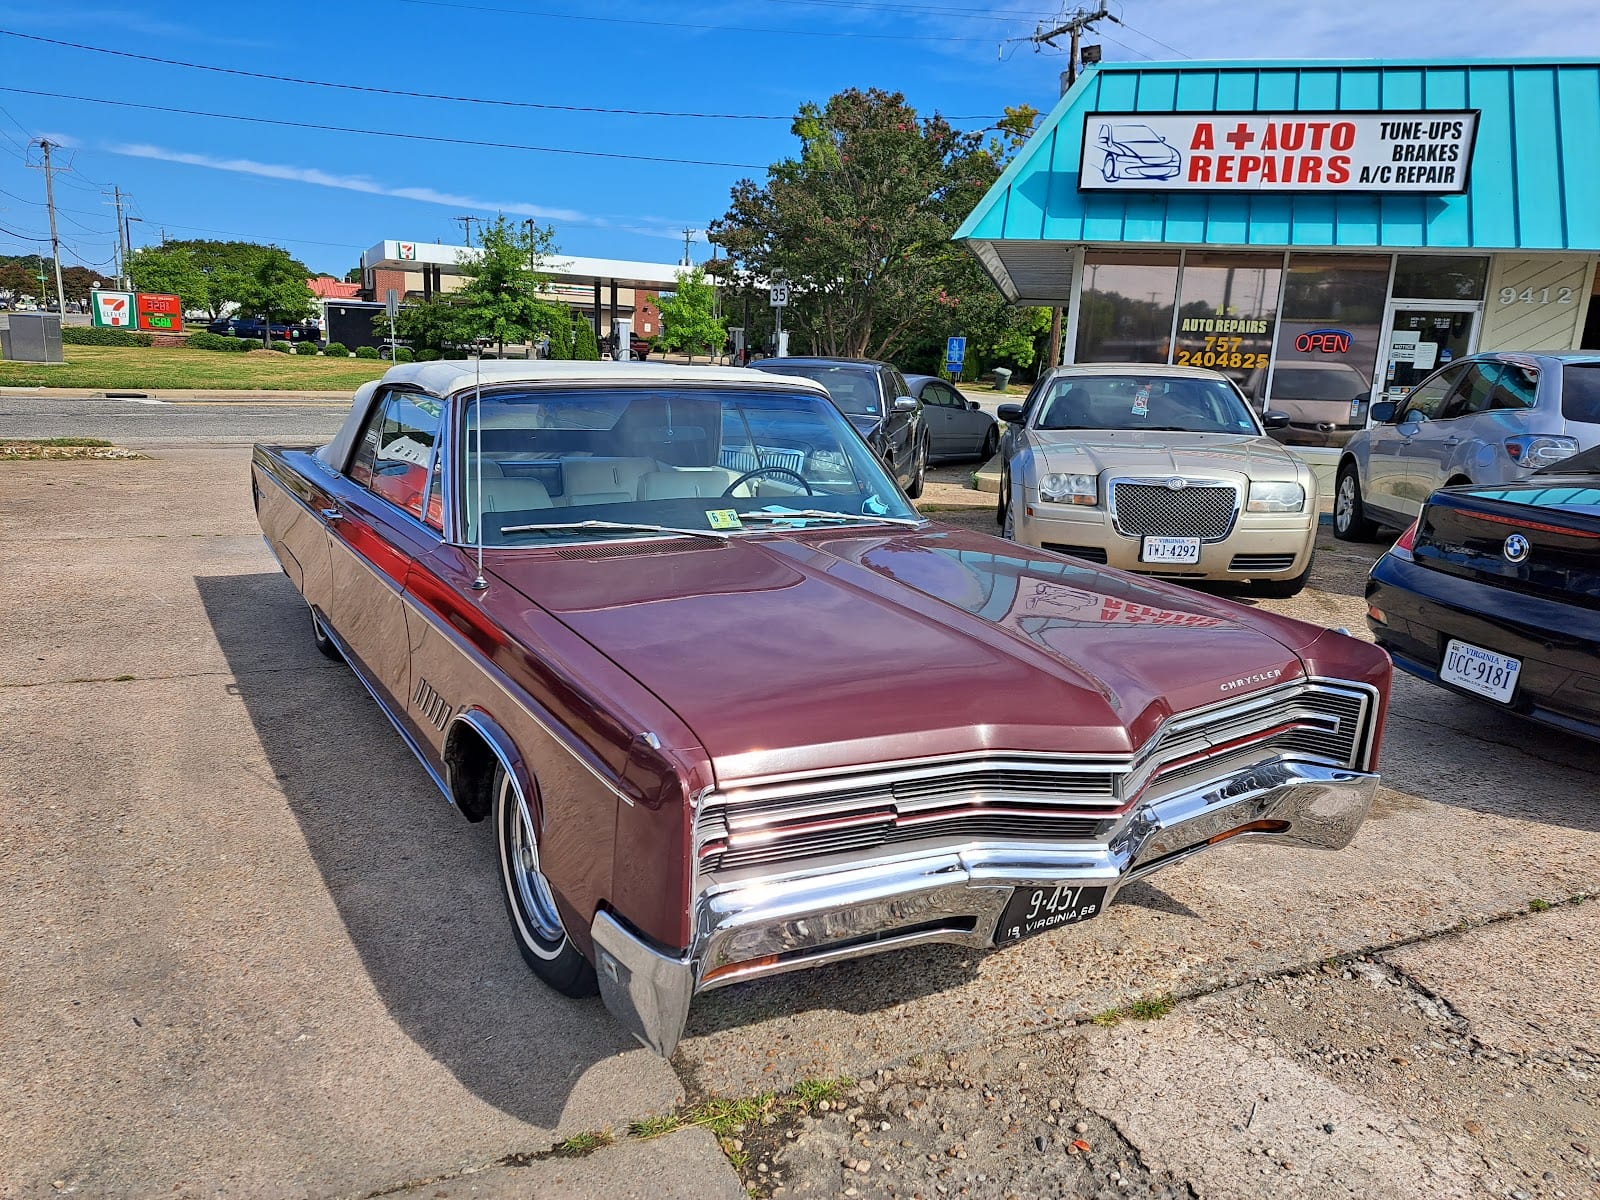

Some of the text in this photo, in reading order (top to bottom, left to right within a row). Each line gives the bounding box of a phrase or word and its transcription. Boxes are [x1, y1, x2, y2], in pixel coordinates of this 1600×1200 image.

[1189, 122, 1215, 150] A
[1260, 122, 1357, 151] AUTO
[1380, 121, 1463, 140] TUNE-UPS
[1392, 144, 1459, 162] BRAKES
[1187, 155, 1351, 183] REPAIRS
[1359, 165, 1456, 184] A/C REPAIR
[102, 298, 125, 311] 7
[772, 288, 786, 302] 35
[1499, 286, 1573, 305] 9412
[1215, 303, 1225, 316] A
[1181, 318, 1267, 334] AUTO REPAIRS
[1204, 336, 1243, 352] 757
[1295, 334, 1350, 352] OPEN
[1178, 350, 1269, 369] 2404825
[1148, 544, 1196, 557] TWJ-4292
[1465, 646, 1500, 665] VIRGINIA
[1220, 669, 1281, 691] CHRYSLER
[1447, 651, 1512, 690] UCC-9181
[1026, 910, 1077, 931] VIRGINIA
[1081, 904, 1096, 916] 68
